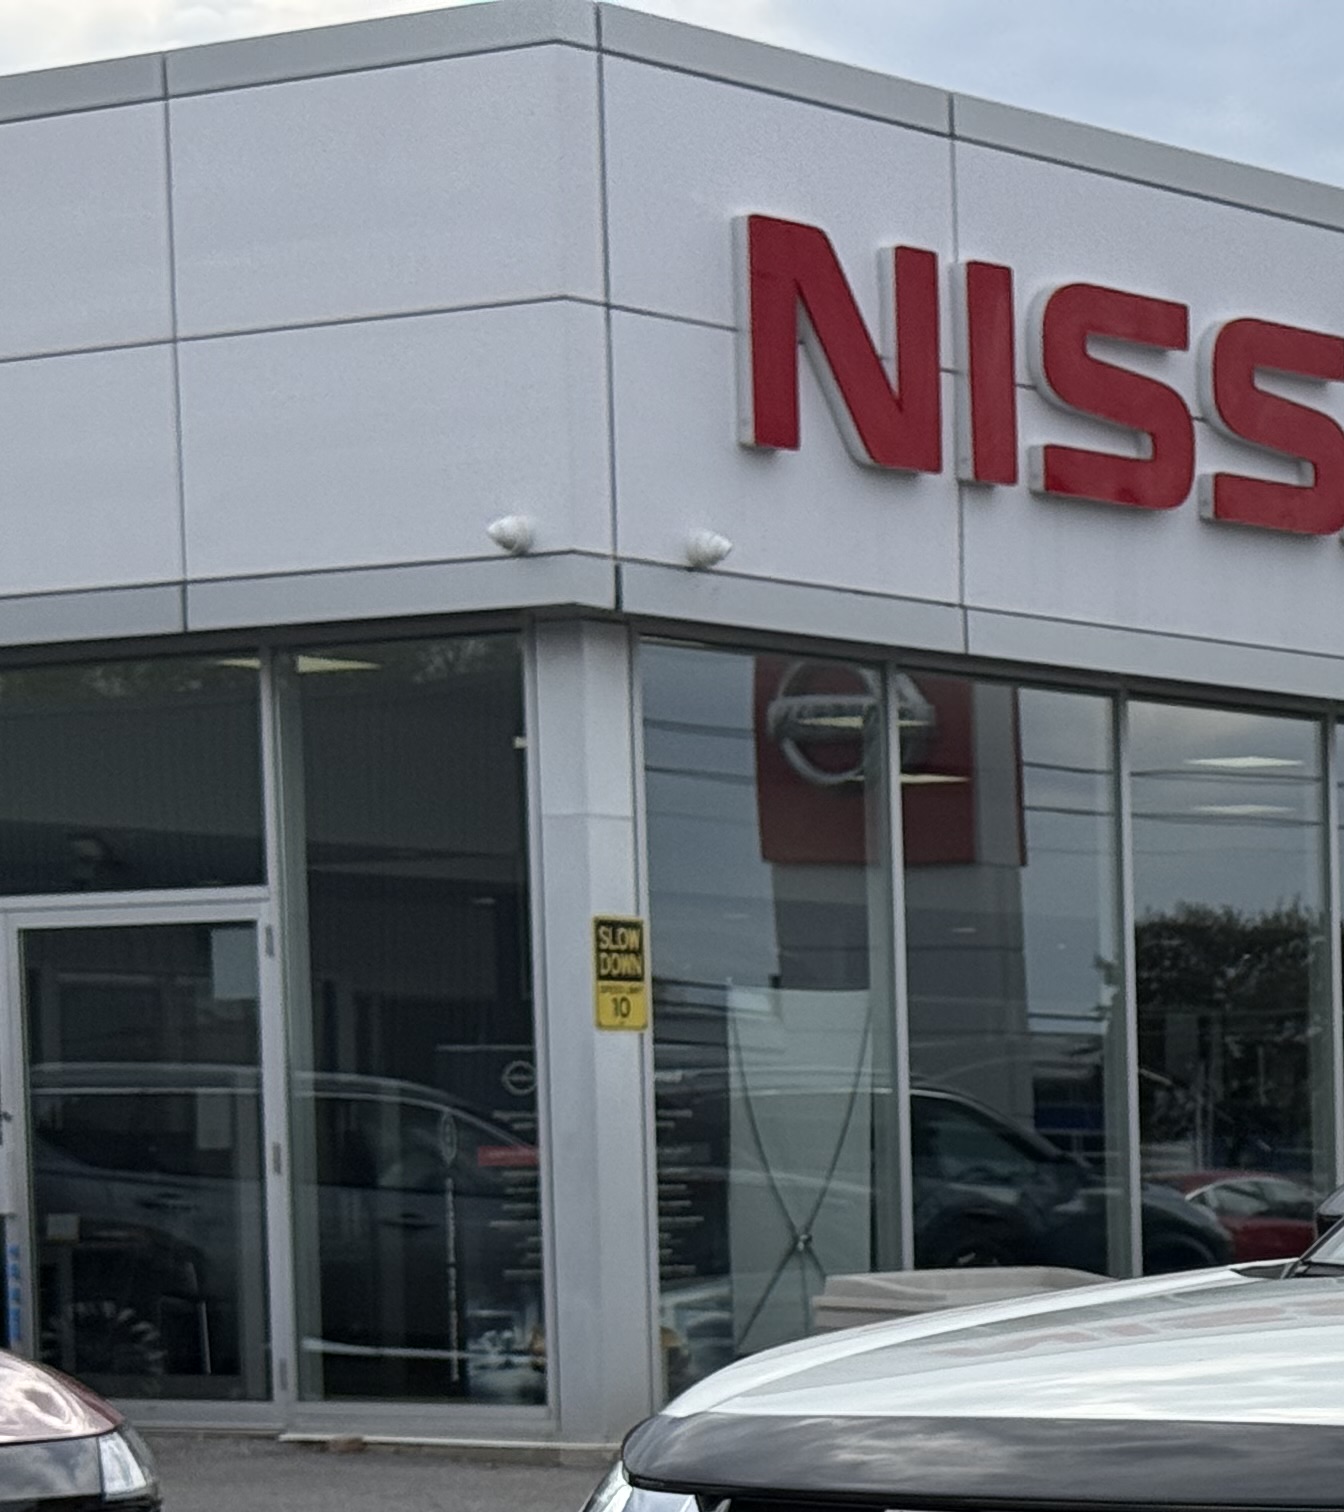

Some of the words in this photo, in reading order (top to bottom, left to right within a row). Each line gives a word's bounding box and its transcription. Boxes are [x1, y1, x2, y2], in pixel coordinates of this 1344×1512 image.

[599, 925, 641, 950] SLOW
[600, 952, 642, 976] DOWN
[611, 996, 631, 1018] 10
